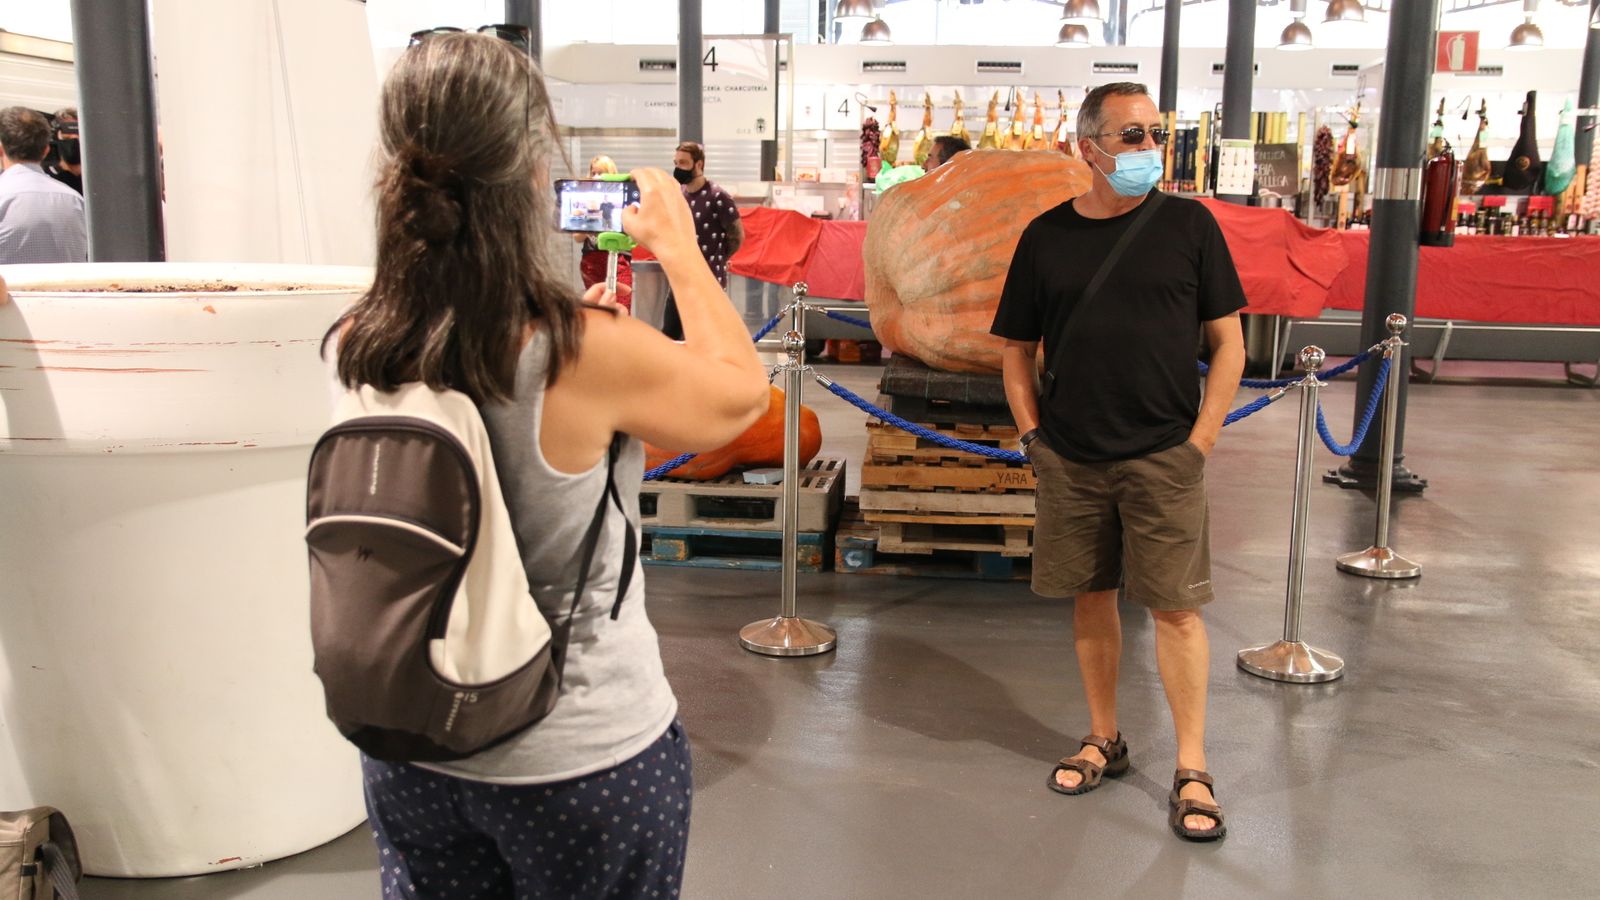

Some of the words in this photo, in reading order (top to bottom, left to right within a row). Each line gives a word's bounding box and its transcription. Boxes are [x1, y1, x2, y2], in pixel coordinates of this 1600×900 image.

[703, 46, 719, 72] 4
[837, 98, 850, 117] 4
[996, 471, 1028, 484] YARA
